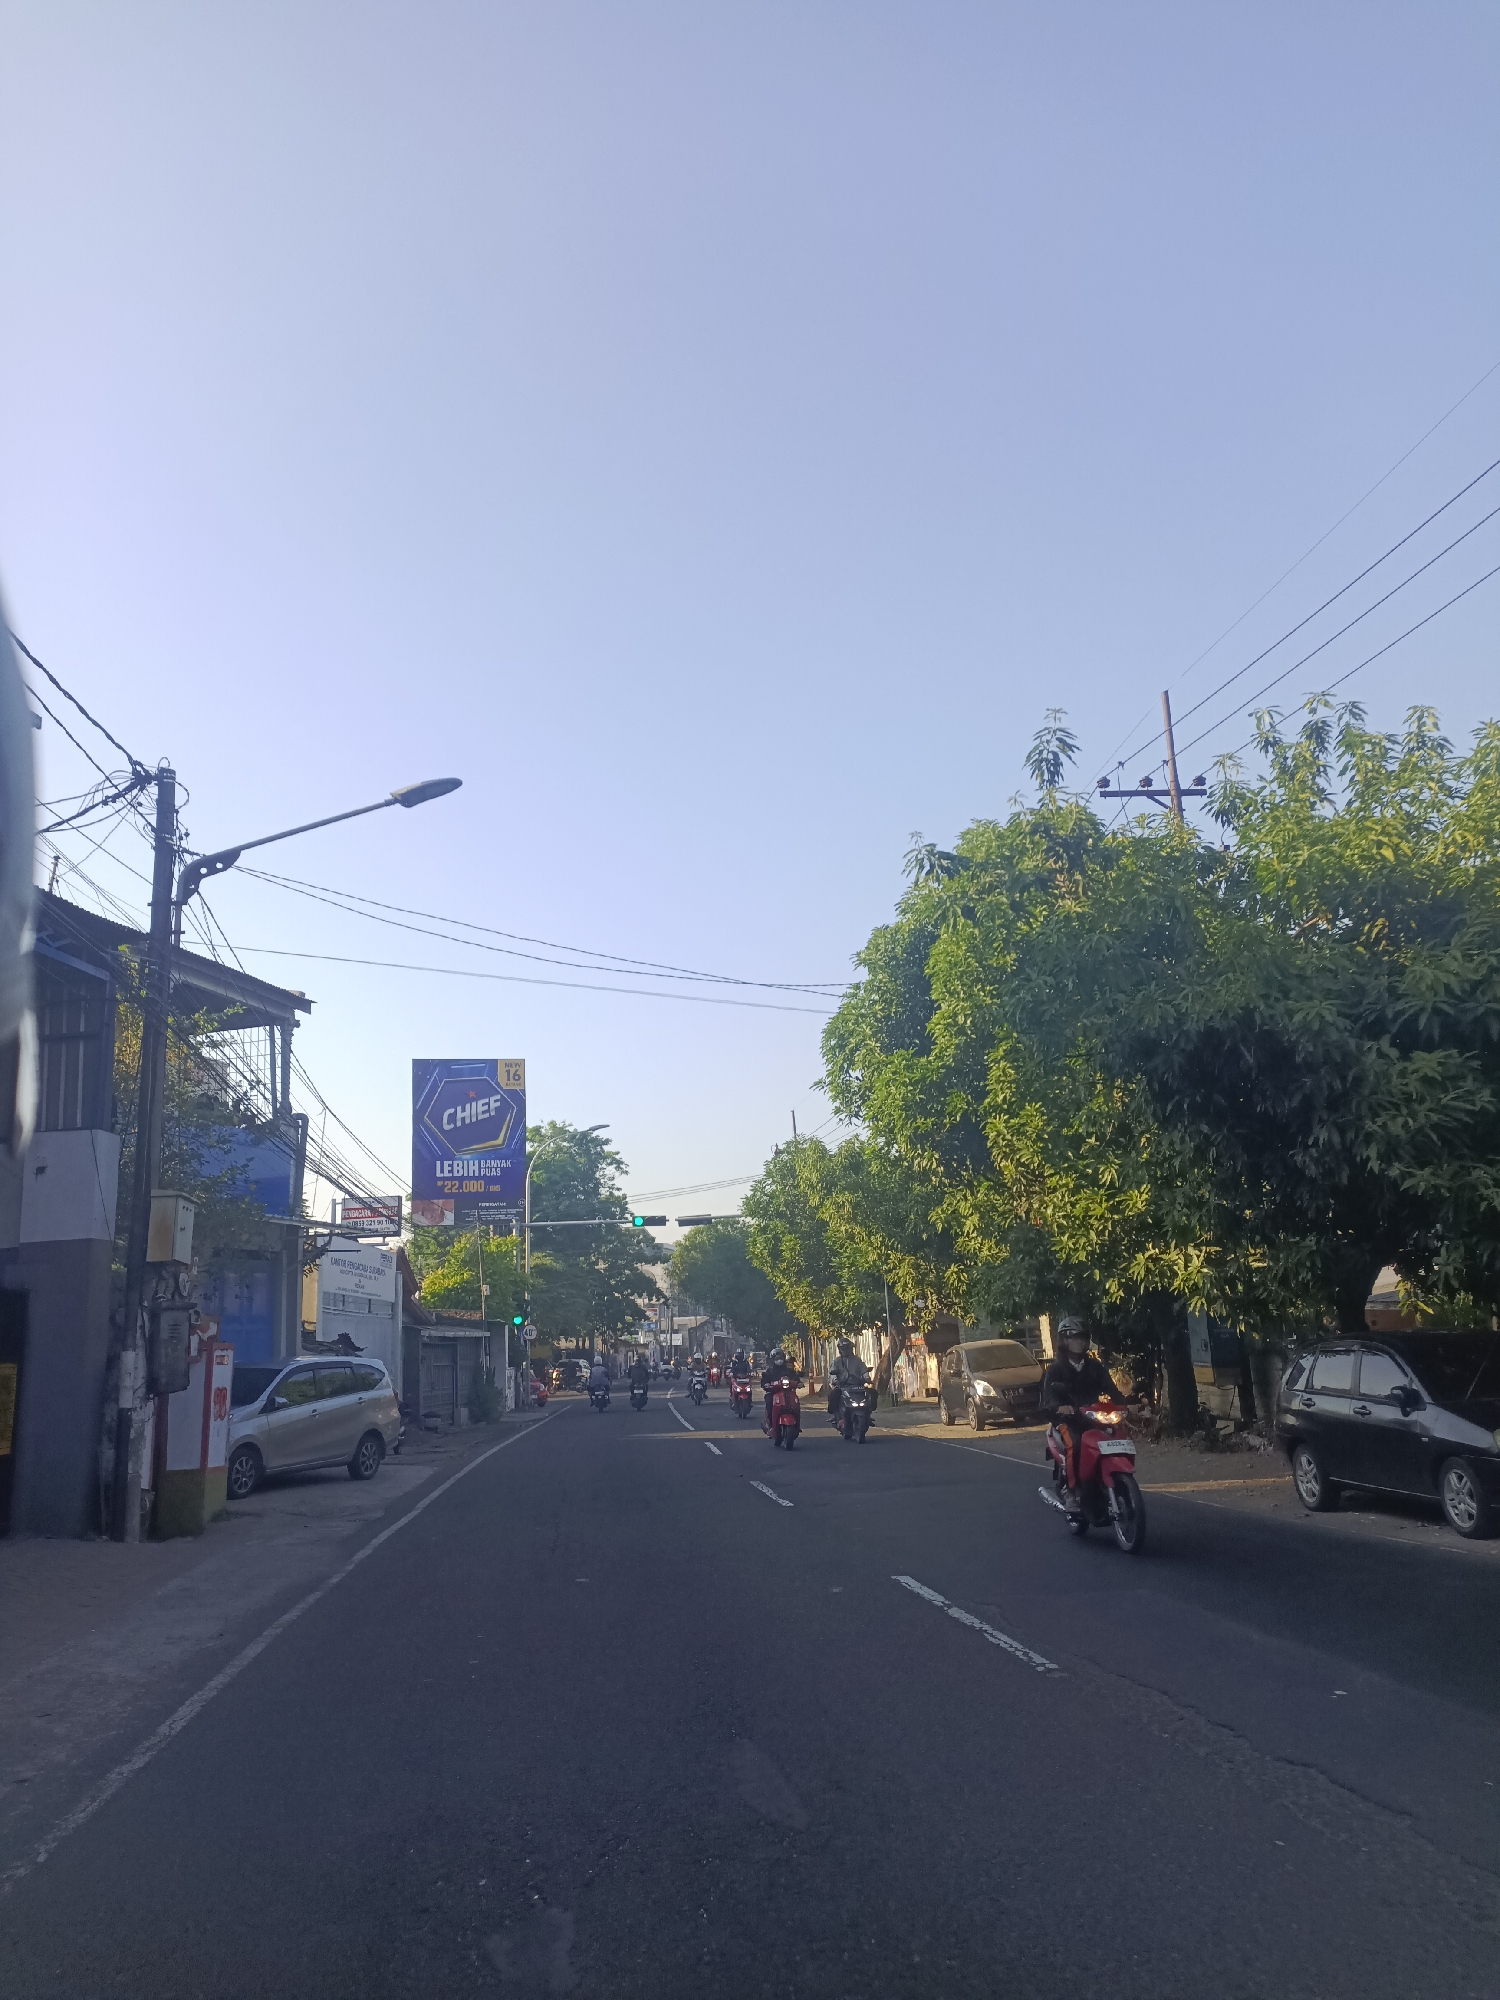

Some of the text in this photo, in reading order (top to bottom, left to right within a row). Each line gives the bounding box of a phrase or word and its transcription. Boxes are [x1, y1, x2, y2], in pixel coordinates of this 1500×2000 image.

[505, 1069, 521, 1081] 16
[442, 1094, 501, 1131] CHIEF
[436, 1160, 479, 1177] LEBIH
[480, 1160, 512, 1168] BANYAK
[480, 1168, 501, 1176] PUAS
[444, 1180, 485, 1193] 22.000
[331, 1257, 346, 1268] KANTOR
[524, 1321, 533, 1337] 40
